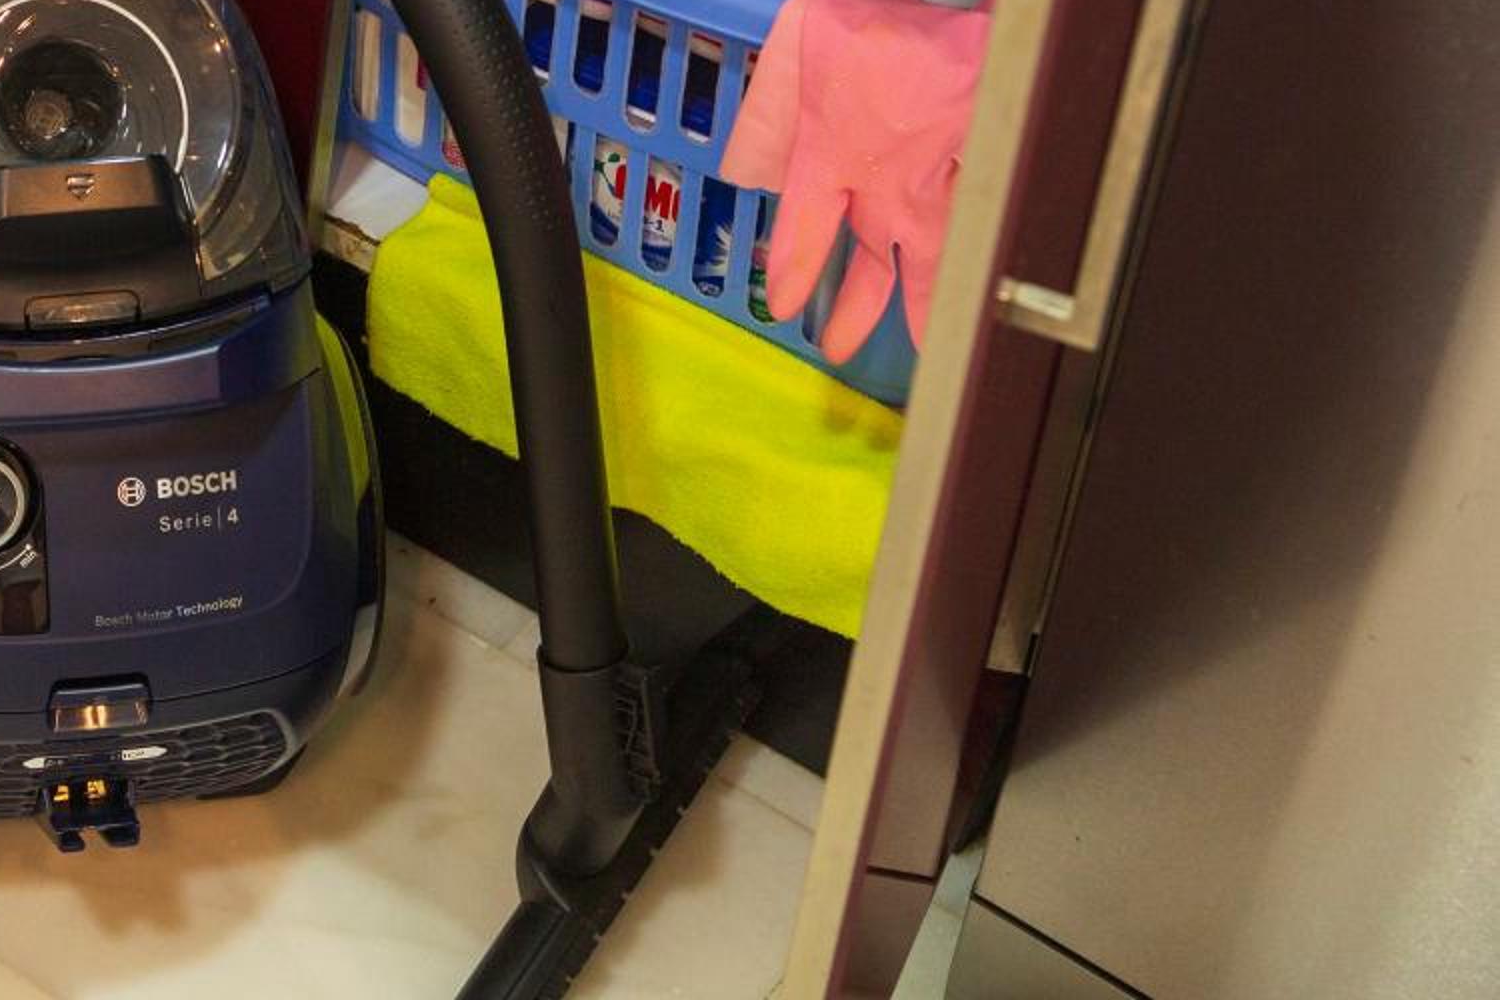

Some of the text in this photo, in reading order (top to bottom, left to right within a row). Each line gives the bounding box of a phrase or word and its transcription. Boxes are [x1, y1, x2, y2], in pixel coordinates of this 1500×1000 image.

[156, 469, 238, 499] BOSCH
[159, 507, 239, 533] Serie 4
[175, 596, 244, 618] Technology
